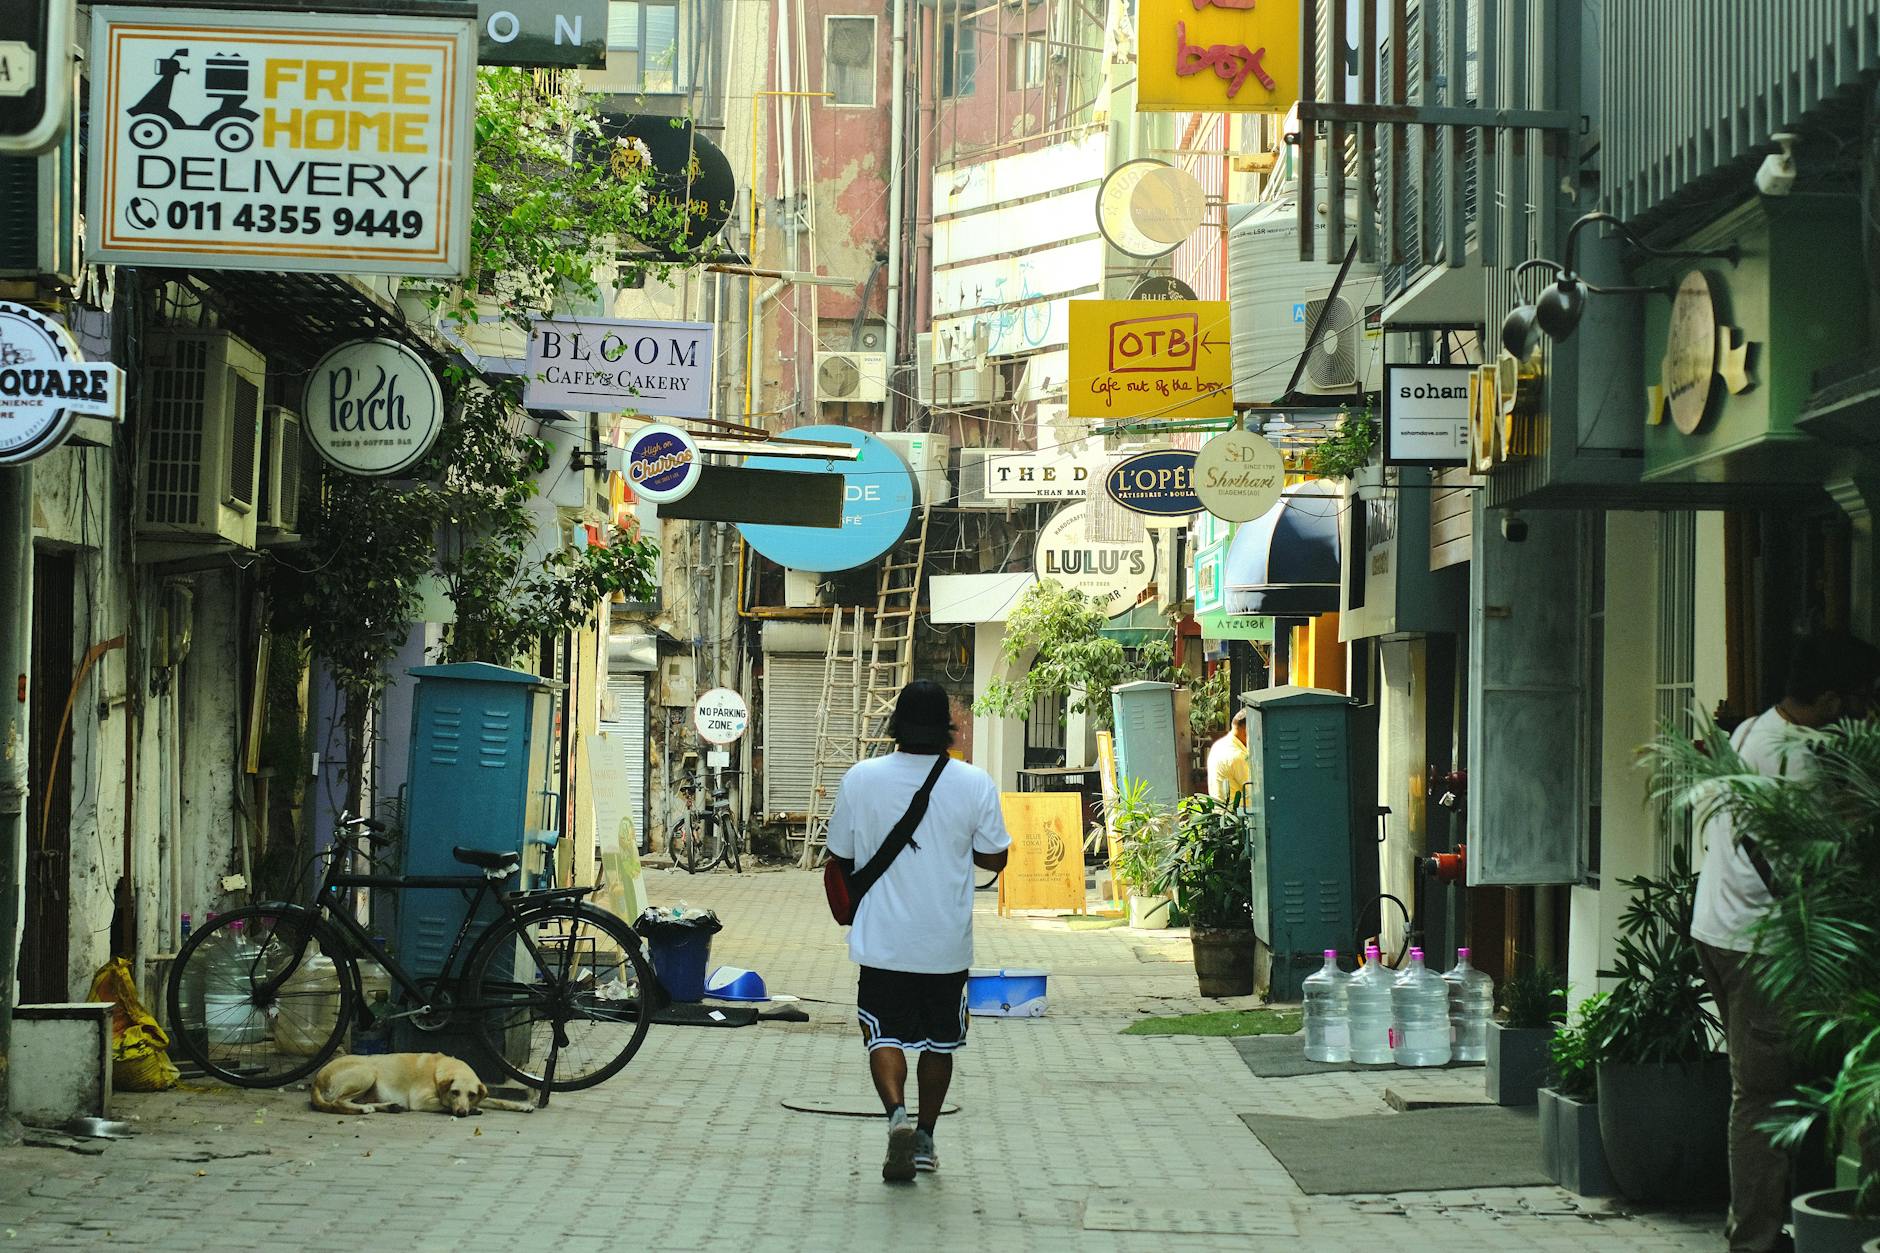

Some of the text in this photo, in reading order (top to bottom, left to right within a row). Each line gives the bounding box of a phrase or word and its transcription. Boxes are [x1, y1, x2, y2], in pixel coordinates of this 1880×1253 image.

[1175, 20, 1275, 99] box
[263, 57, 433, 105] FREE
[262, 106, 429, 154] HOME
[136, 155, 428, 199] DELIVERY
[167, 201, 424, 239] 011 4355 9449
[540, 331, 699, 368] BLOOM
[1118, 328, 1191, 358] OTB
[617, 370, 690, 391] CAKERY
[1091, 376, 1227, 407] Cafe out of the box
[1400, 383, 1468, 399] soham
[641, 440, 673, 457] High on
[629, 448, 694, 482] Churros
[997, 466, 1057, 481] THE
[1207, 466, 1275, 488] Shrihari
[844, 484, 881, 501] DE
[1045, 549, 1147, 575] LULU'S
[699, 706, 747, 718] NO PARKING
[707, 719, 733, 730] ZONE
